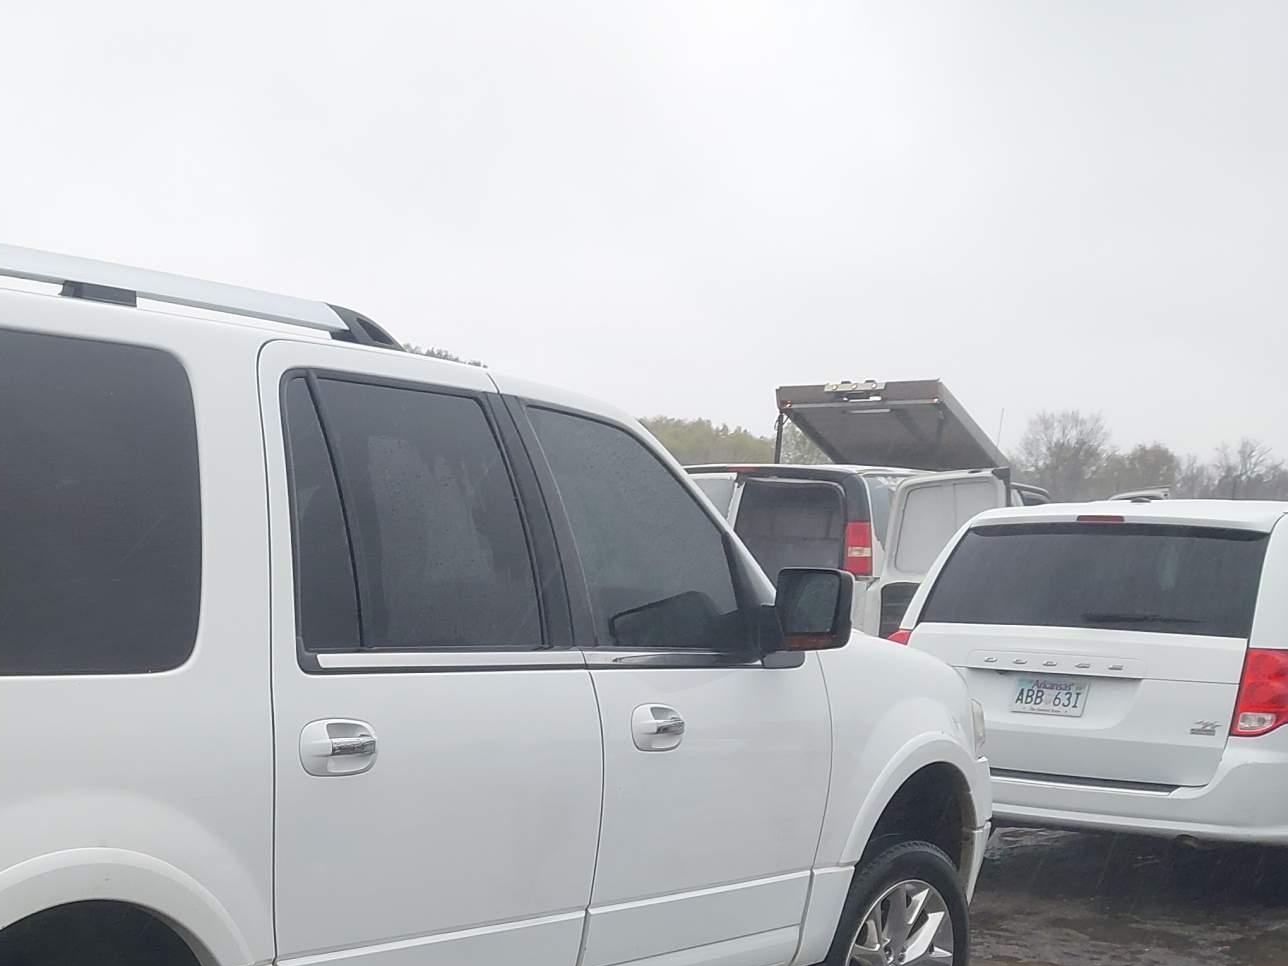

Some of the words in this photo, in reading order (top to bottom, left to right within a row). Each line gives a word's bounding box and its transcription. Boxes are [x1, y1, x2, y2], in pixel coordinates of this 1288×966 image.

[984, 656, 1124, 671] DODGE
[1032, 679, 1075, 691] Arkansas
[1015, 687, 1044, 705] ABB
